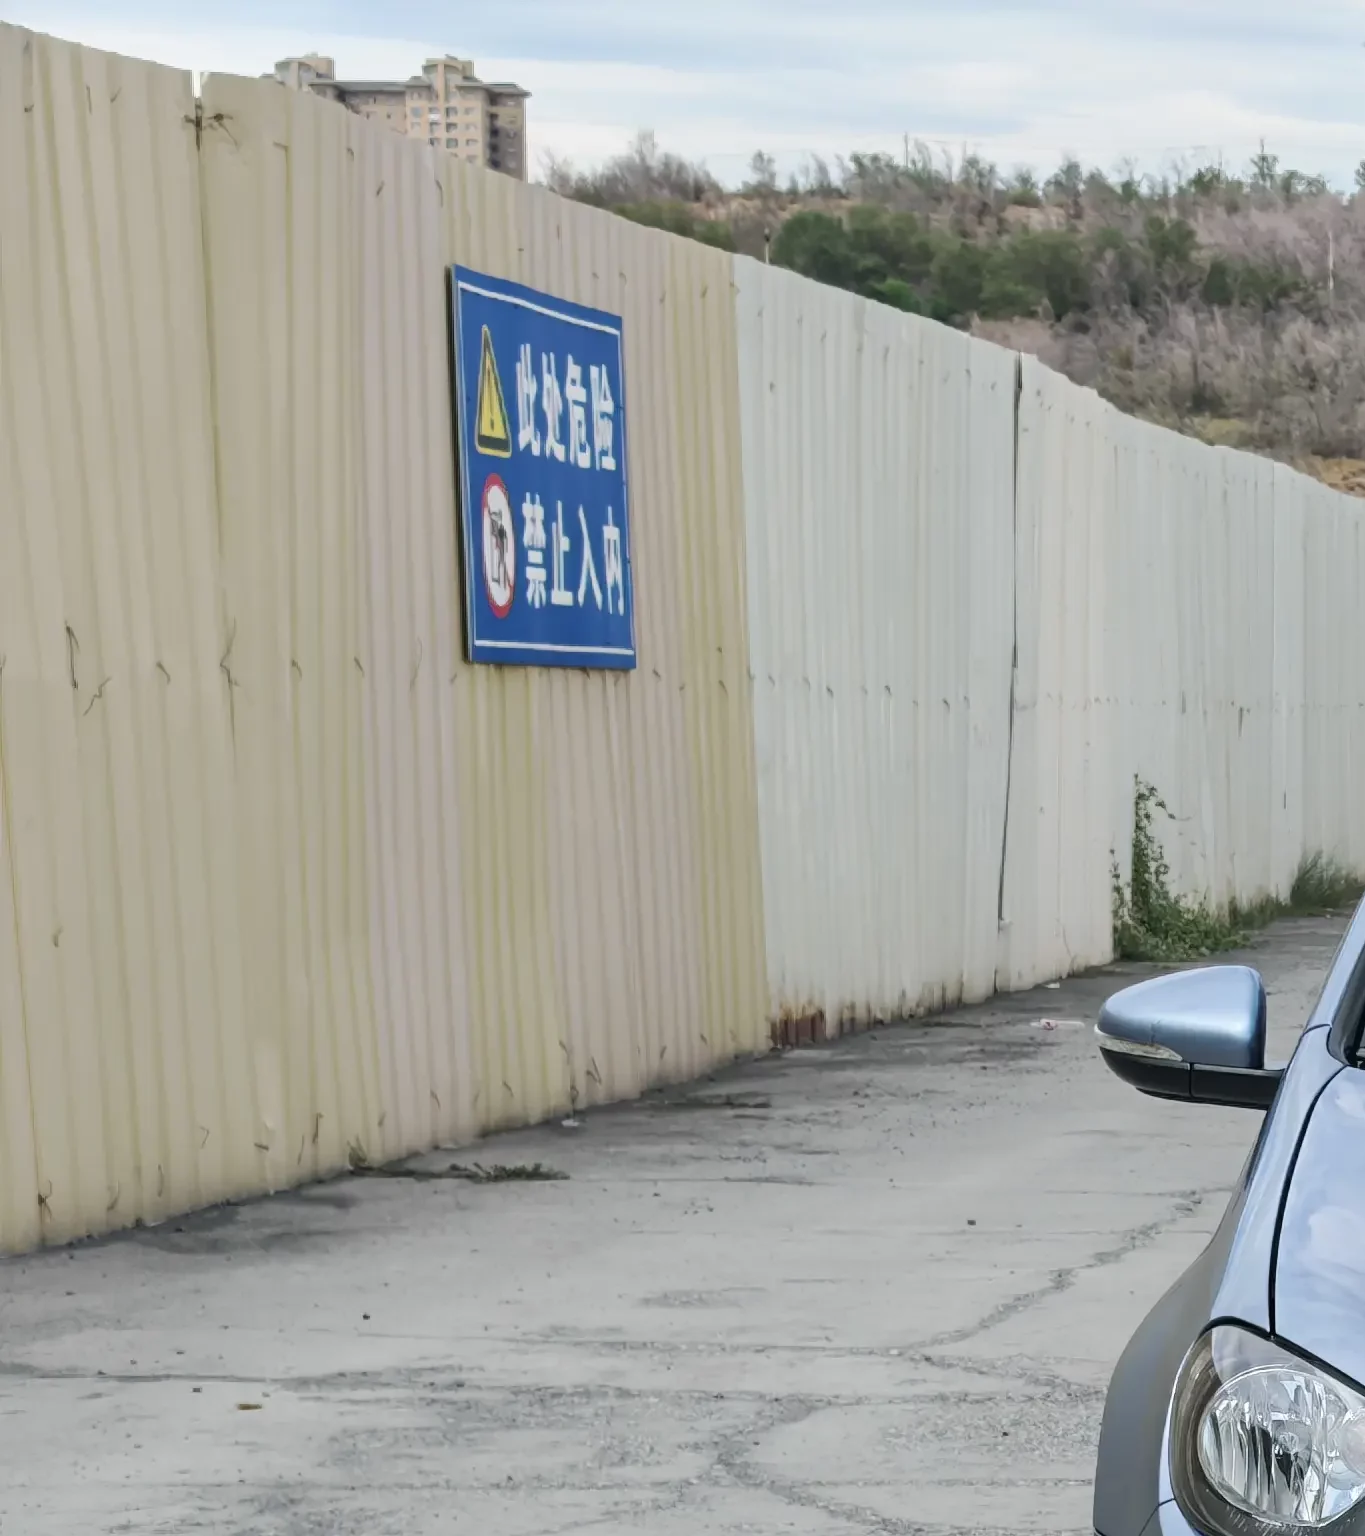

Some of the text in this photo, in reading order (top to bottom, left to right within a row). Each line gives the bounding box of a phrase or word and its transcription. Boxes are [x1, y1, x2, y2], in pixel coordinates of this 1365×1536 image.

[516, 343, 616, 471] 此处危险
[521, 491, 625, 616] 禁止入内
